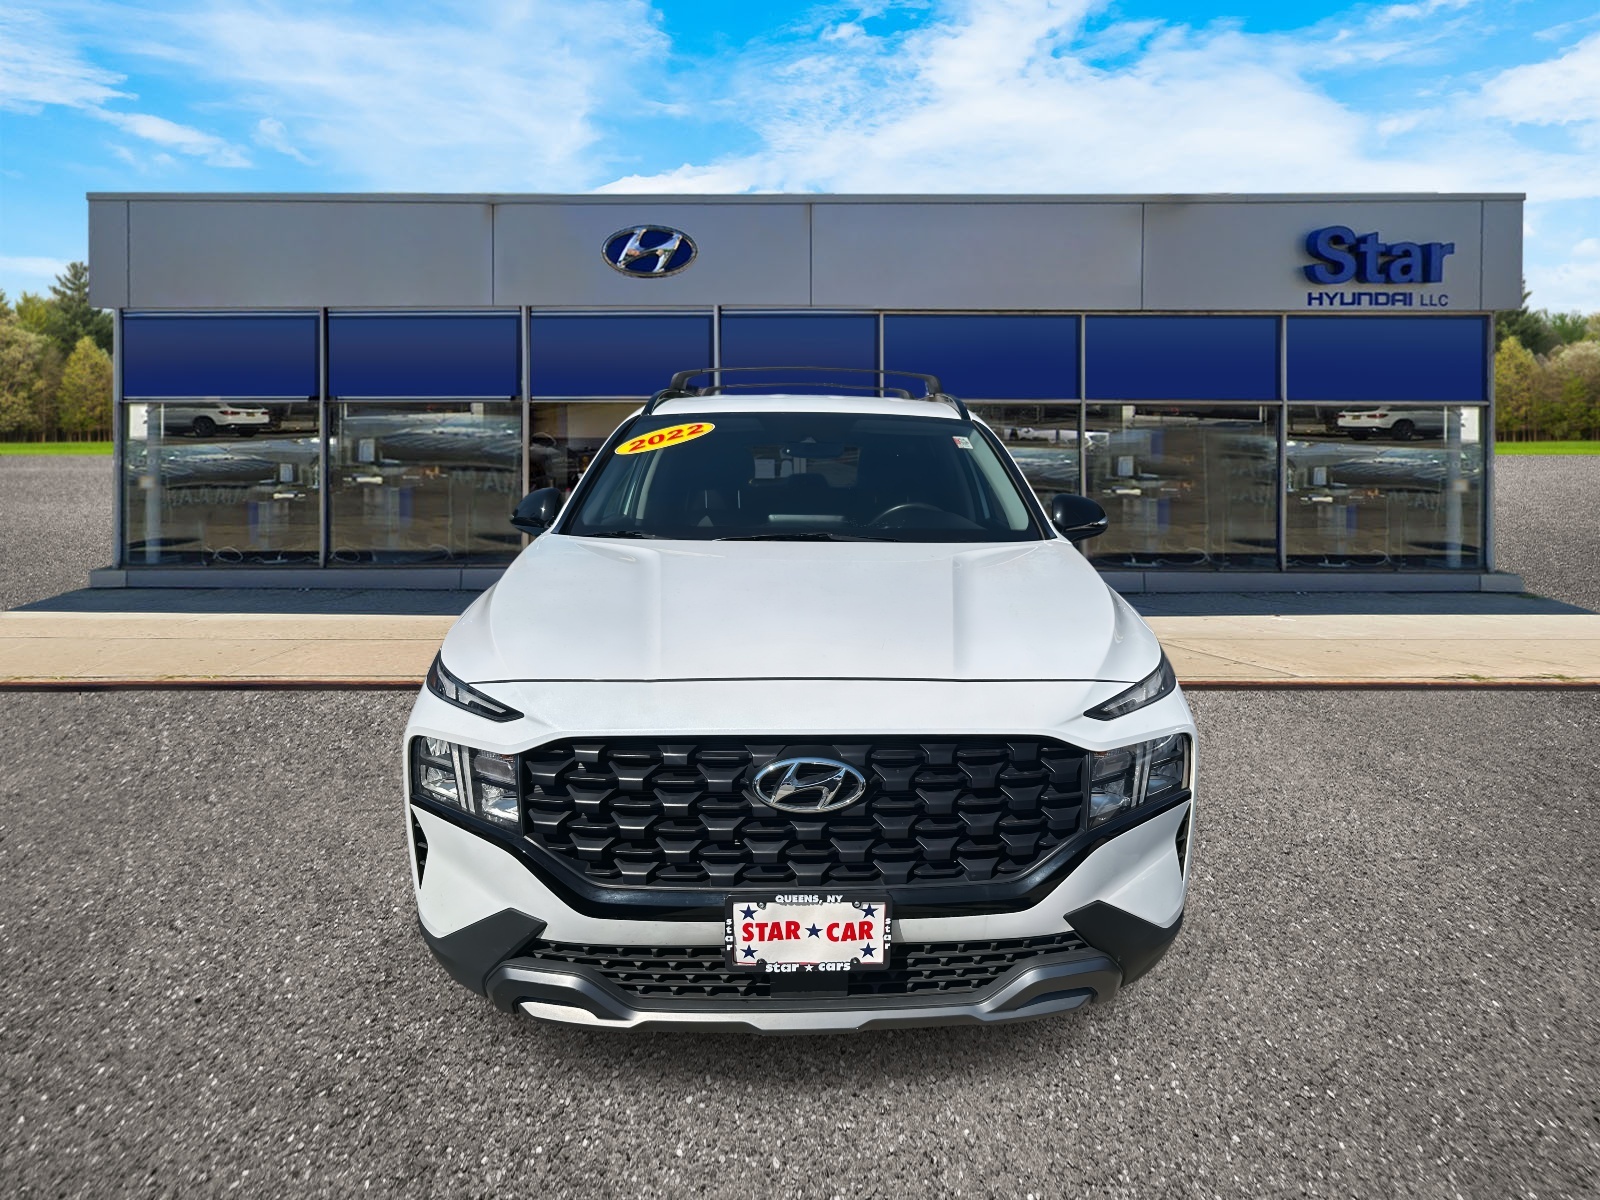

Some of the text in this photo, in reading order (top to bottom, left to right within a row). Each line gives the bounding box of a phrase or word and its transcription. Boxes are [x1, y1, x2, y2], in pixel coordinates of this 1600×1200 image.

[1303, 225, 1455, 285] Star
[1307, 292, 1449, 307] HYUNDAI LLC
[628, 424, 704, 452] 2022
[775, 894, 844, 904] QUEENS, NY
[725, 918, 733, 951] star
[742, 920, 874, 942] STAR CAR
[883, 917, 892, 949] star
[765, 961, 851, 973] star cars
